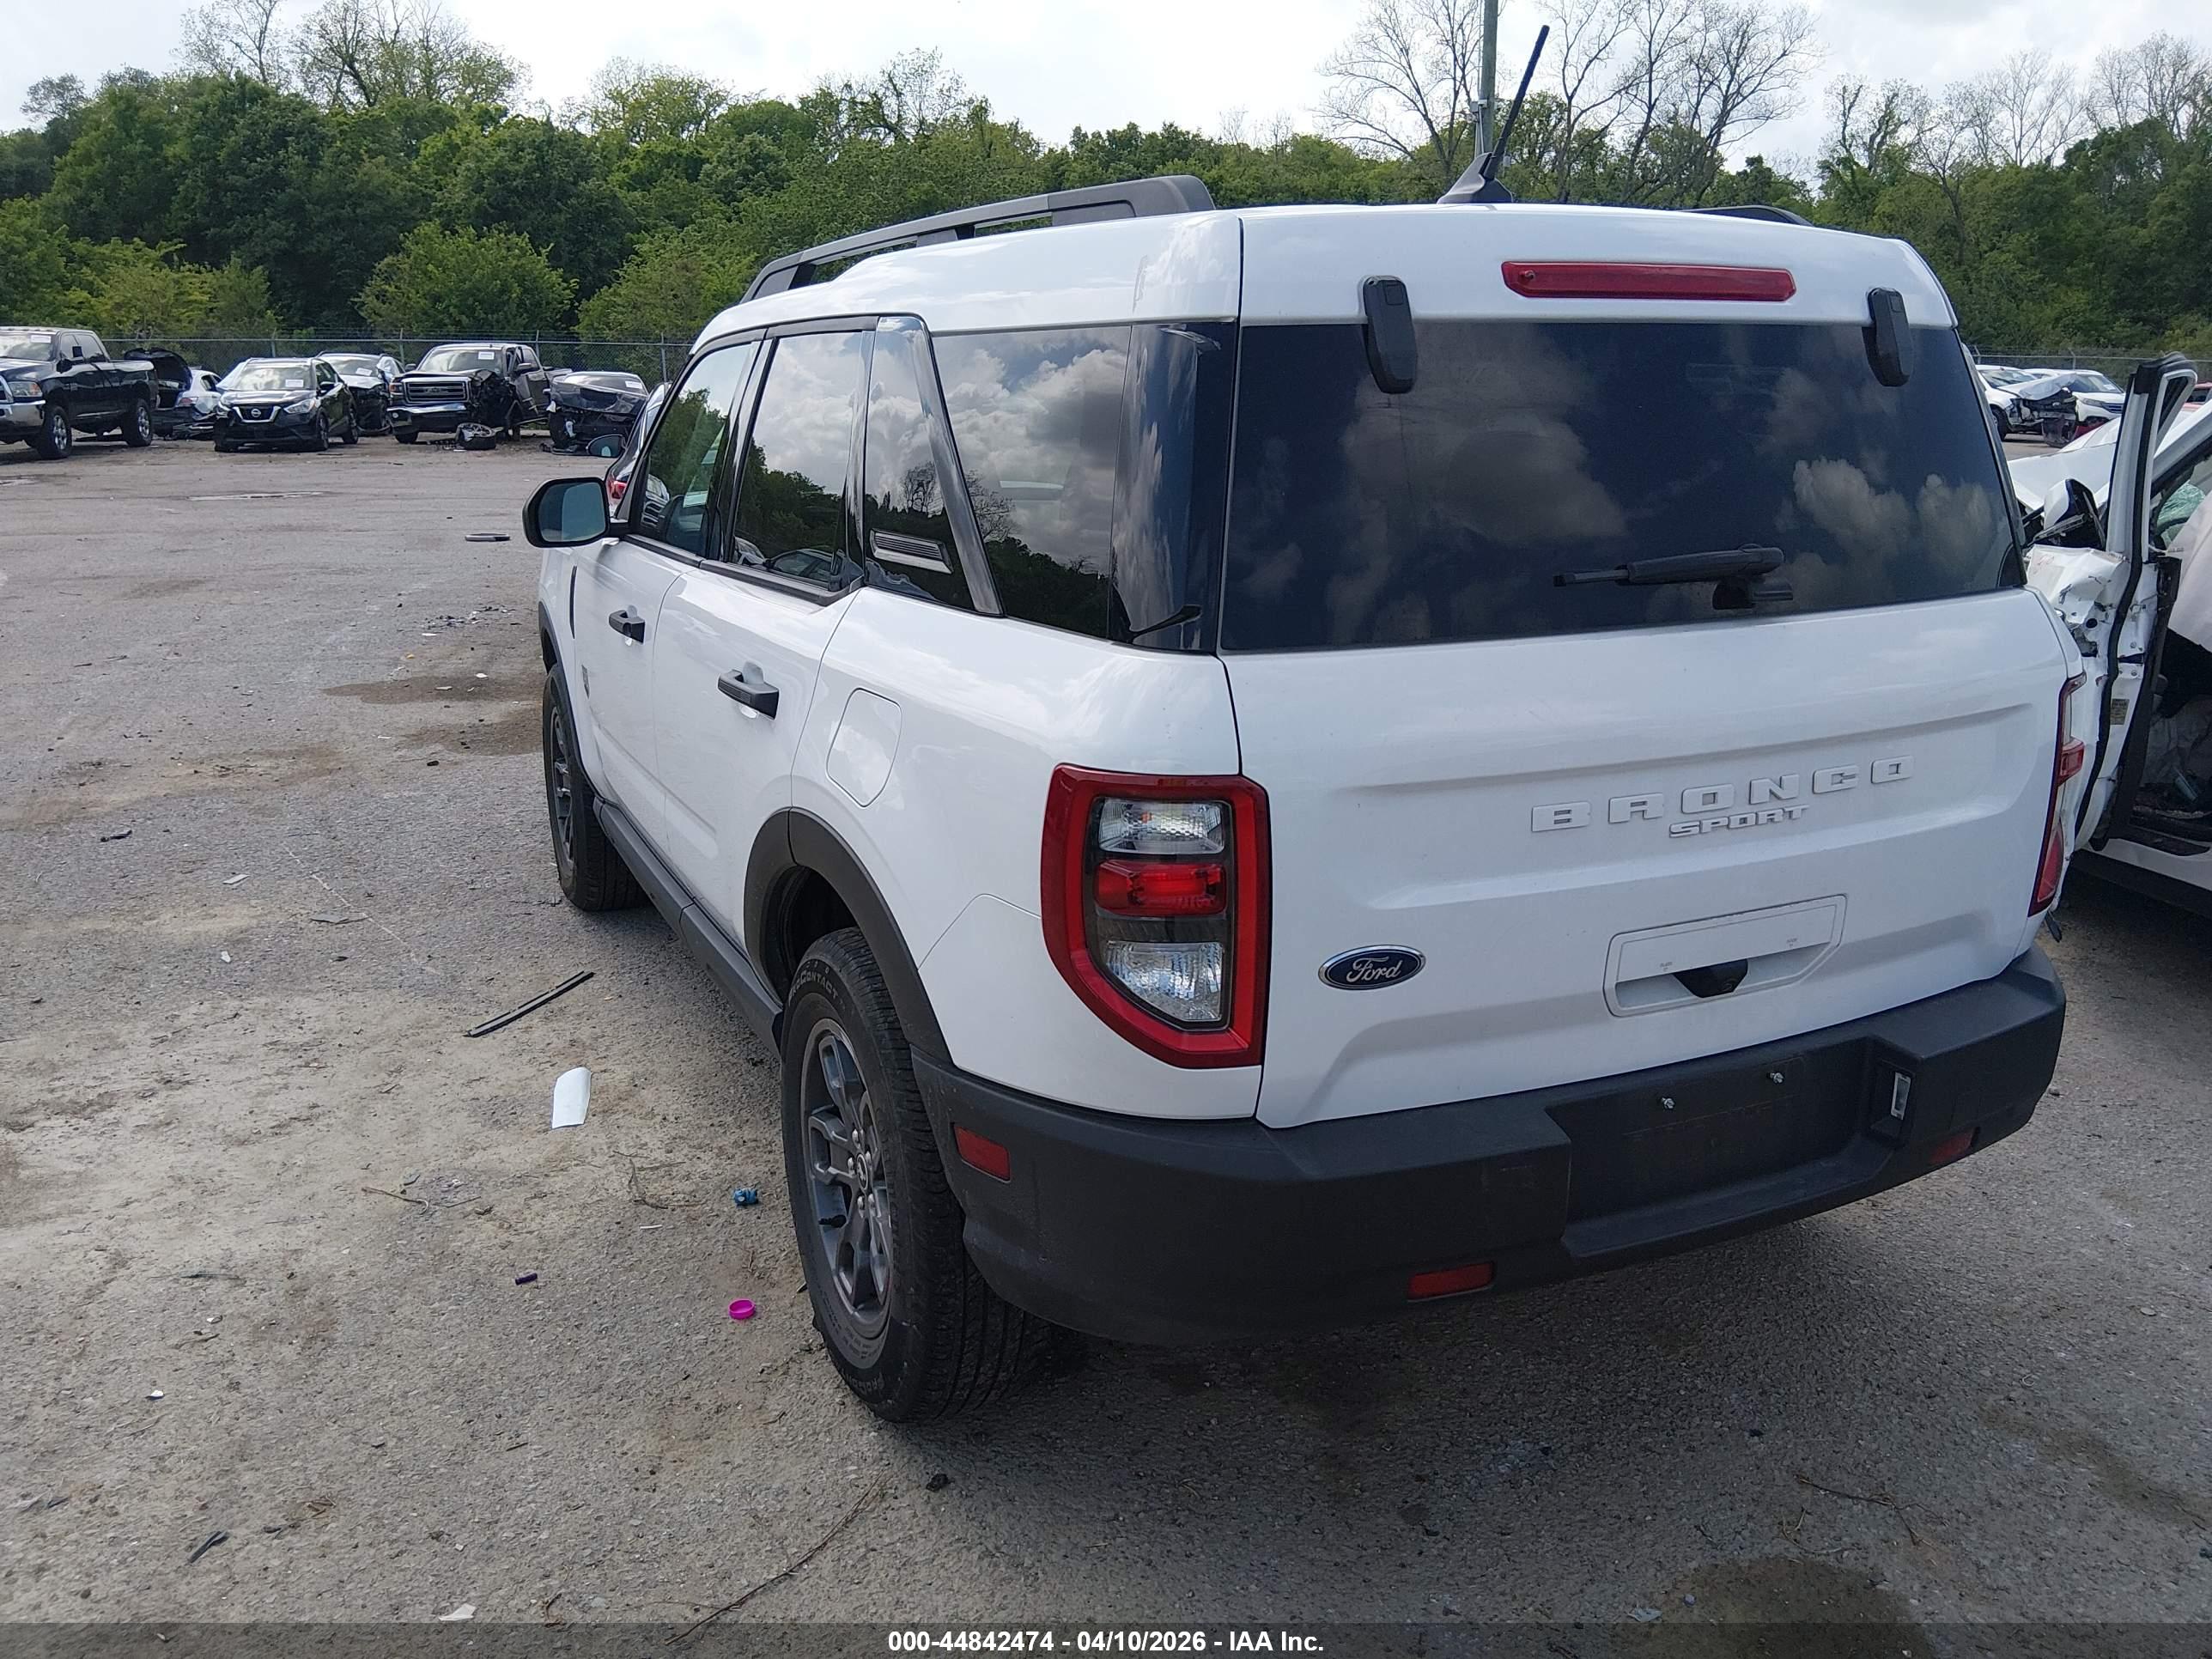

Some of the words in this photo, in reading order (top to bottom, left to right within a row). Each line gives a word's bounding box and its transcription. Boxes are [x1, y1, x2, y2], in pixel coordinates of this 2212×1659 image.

[1531, 756, 1913, 832] BRONCO
[1668, 805, 1809, 838] SPORT
[1346, 956, 1403, 982] Ford
